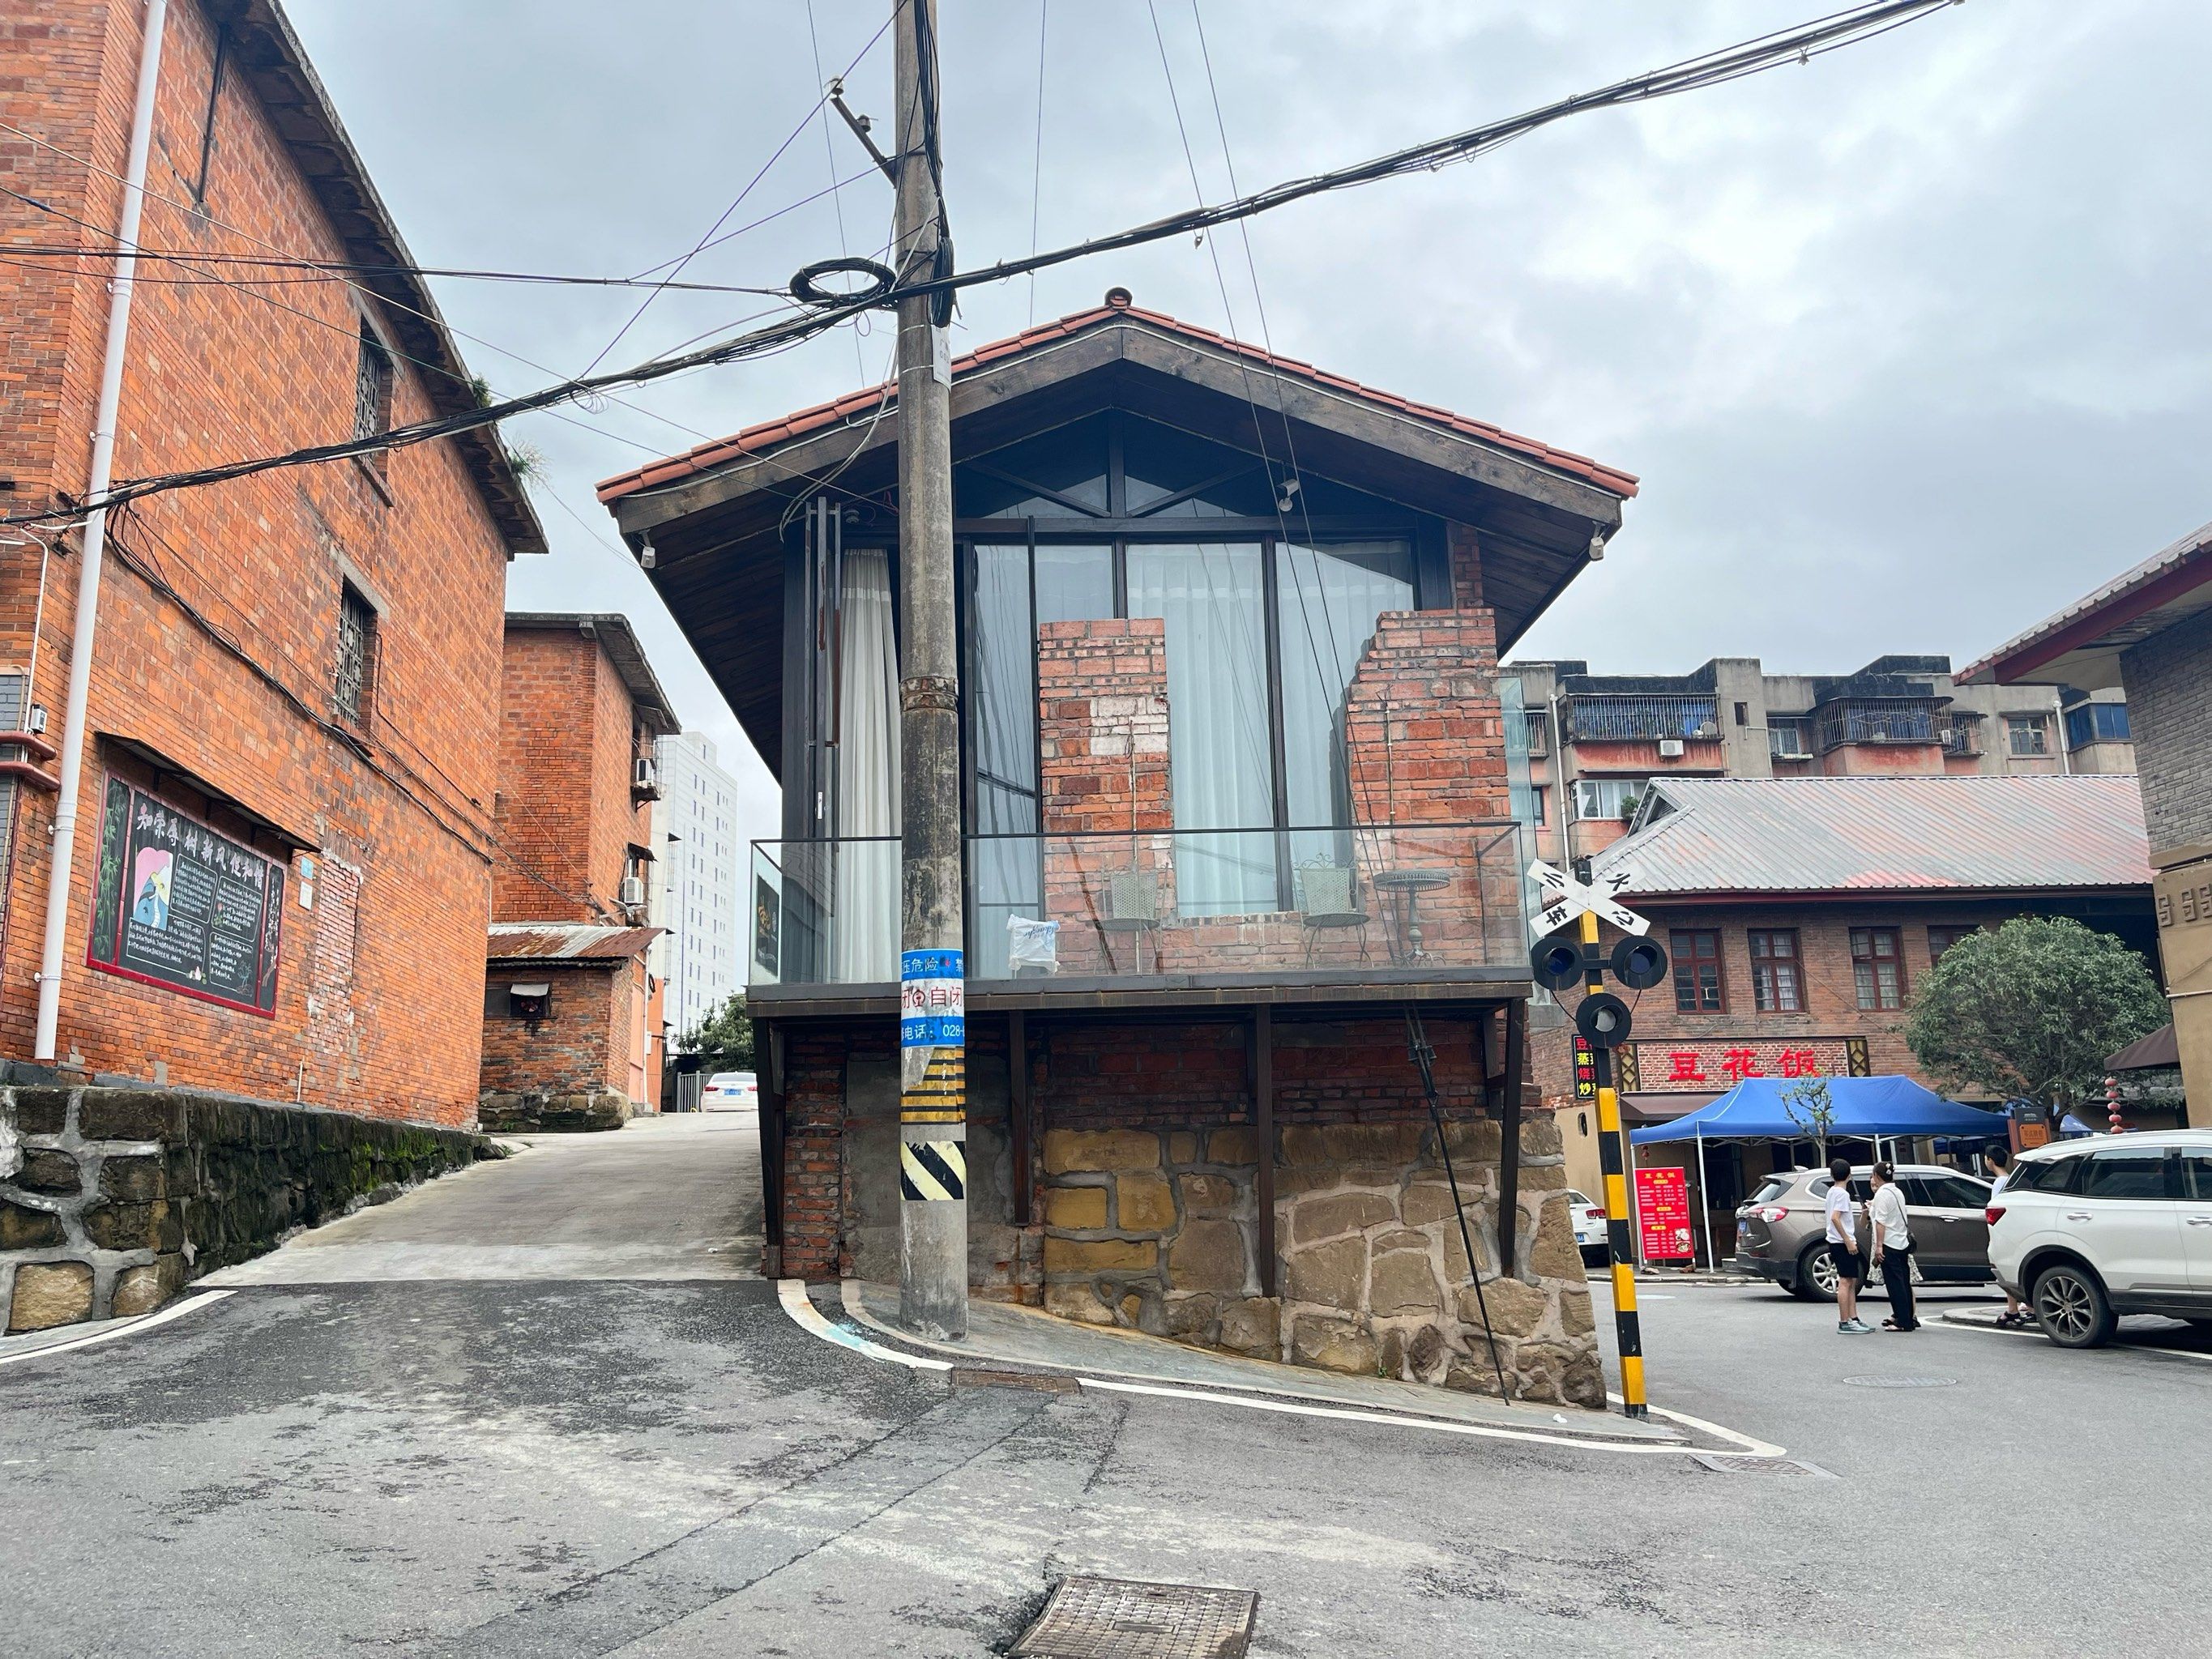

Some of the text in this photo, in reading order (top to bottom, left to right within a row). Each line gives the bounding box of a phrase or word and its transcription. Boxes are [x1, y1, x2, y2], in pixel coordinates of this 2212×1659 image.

[931, 986, 962, 1007] 自闭
[901, 1023, 964, 1041] 电话： 028-
[1576, 1038, 1593, 1051] 豆
[1668, 1047, 1822, 1081] 豆花饭
